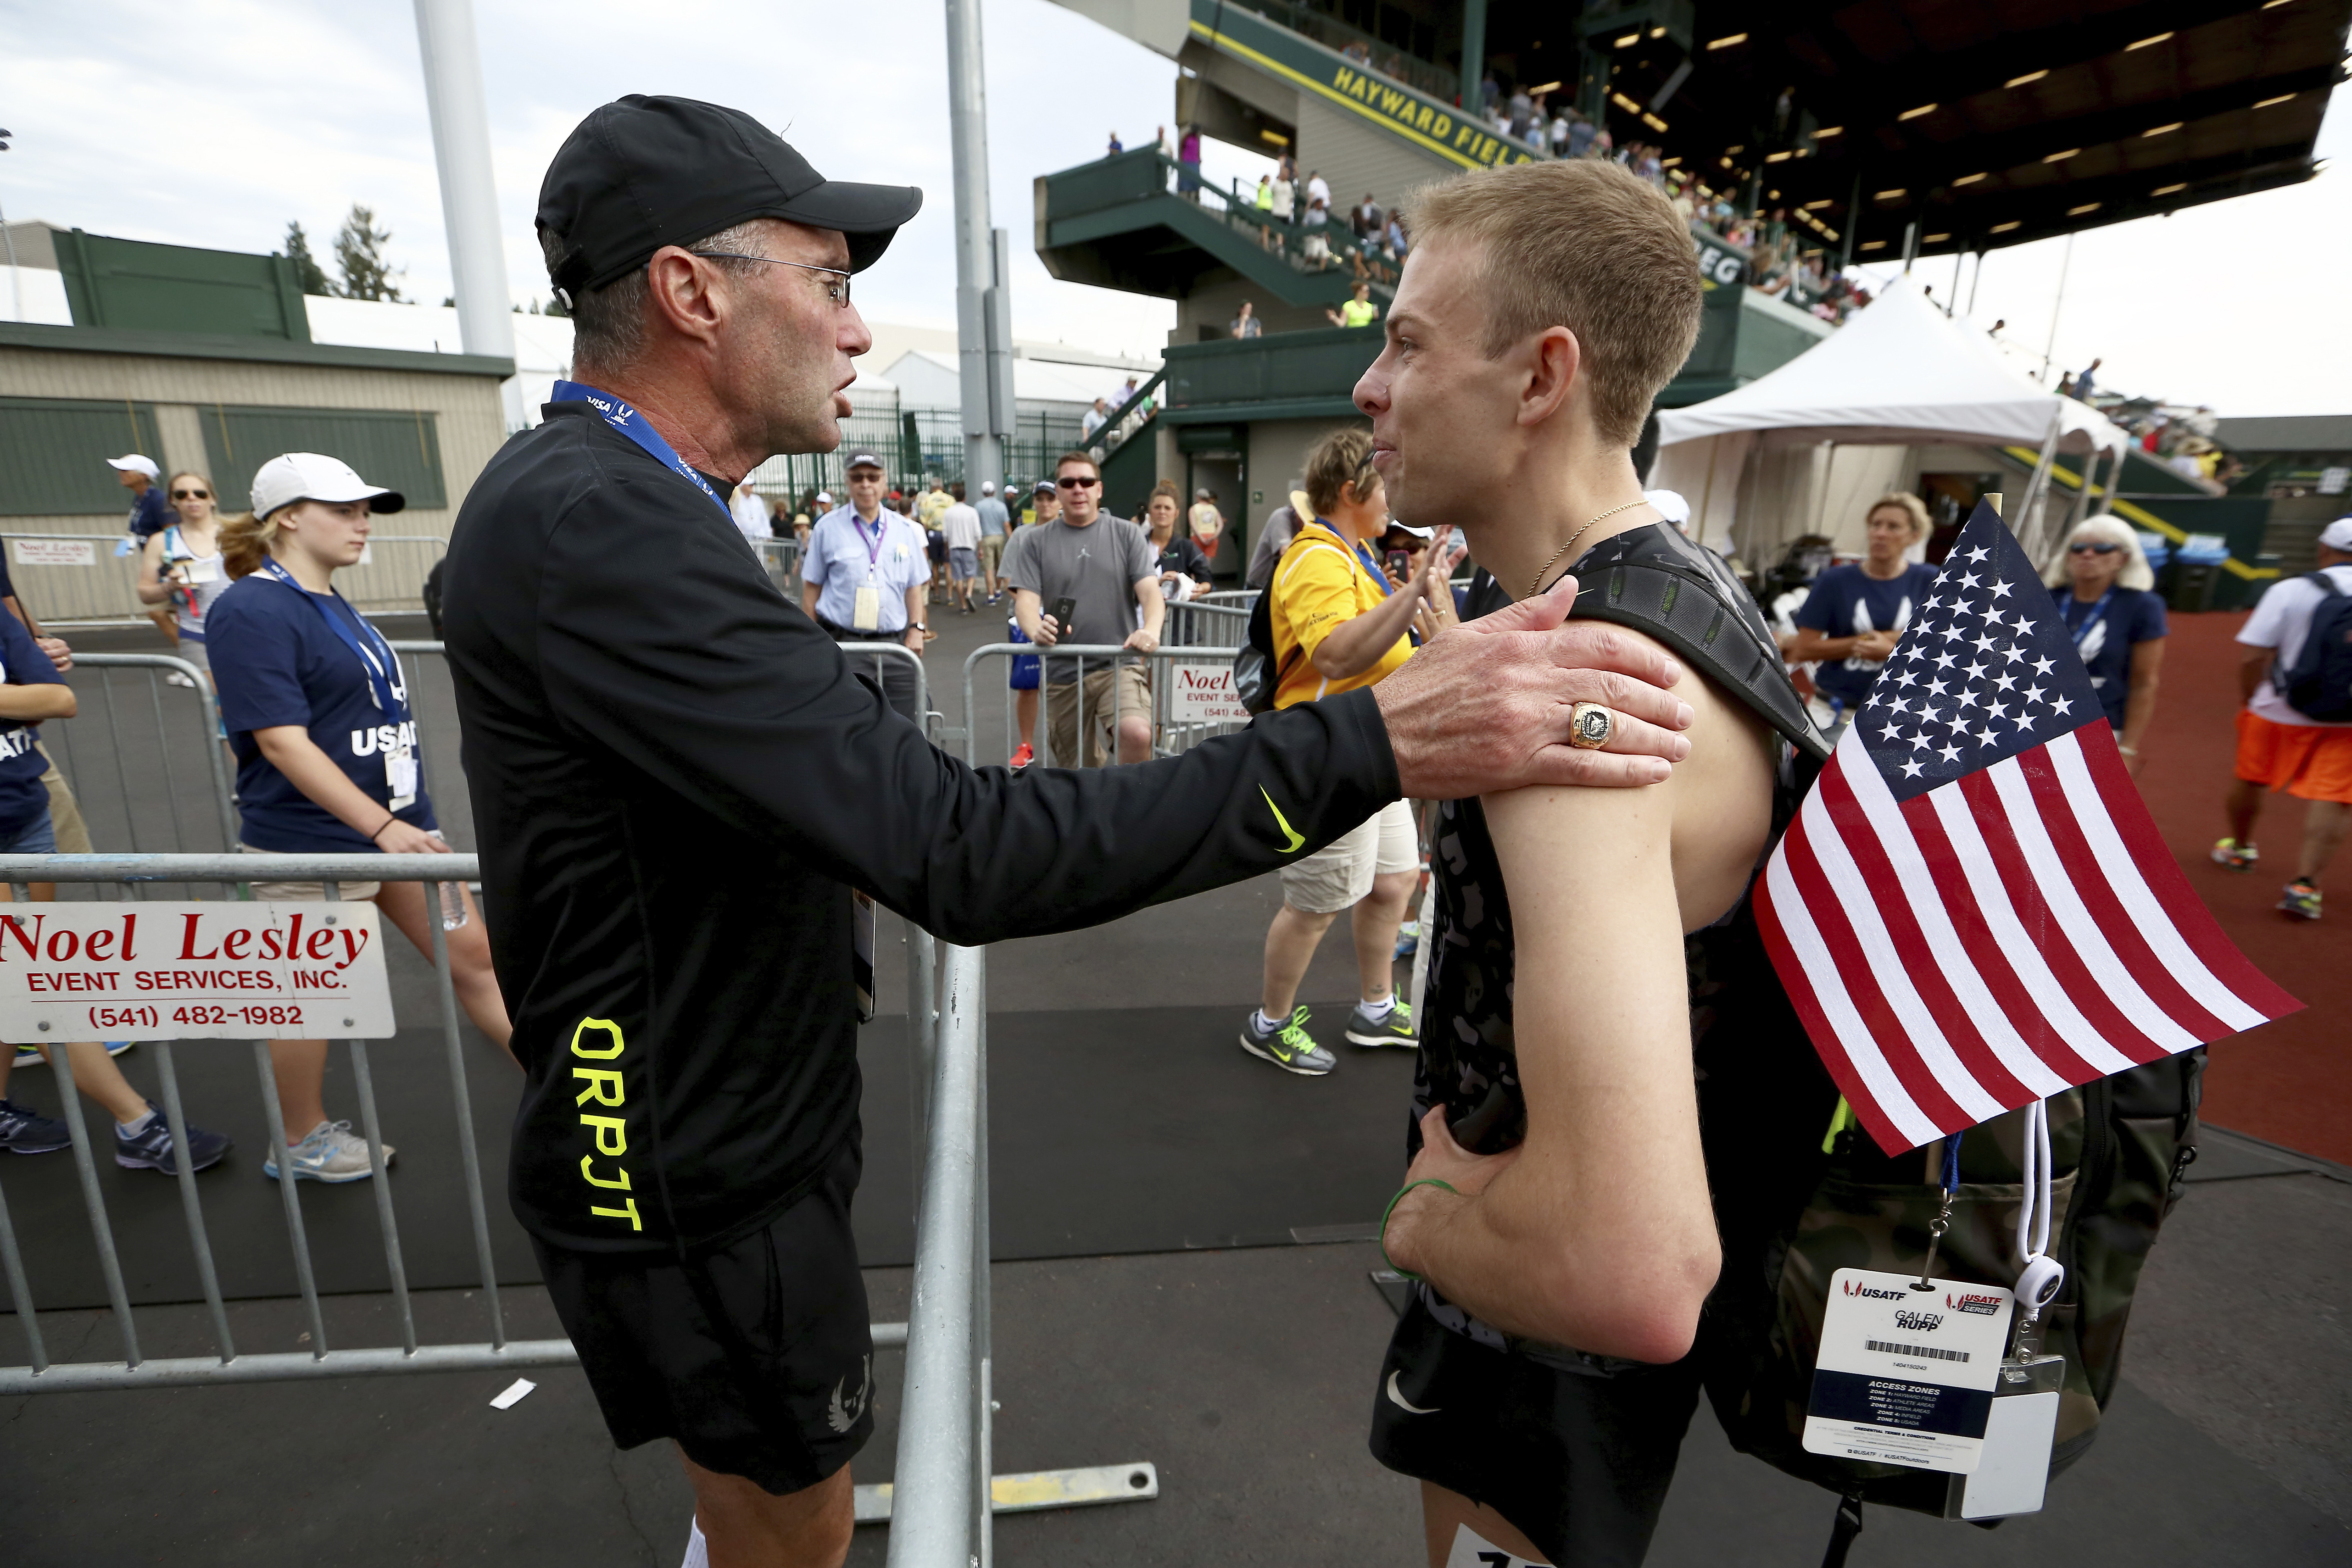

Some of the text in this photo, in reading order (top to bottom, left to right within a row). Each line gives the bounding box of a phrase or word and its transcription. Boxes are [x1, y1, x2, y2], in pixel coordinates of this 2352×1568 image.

[1333, 66, 1452, 139] HAYWARD
[586, 395, 611, 412] VISA
[677, 455, 697, 481] VISA
[1178, 669, 1230, 689] Noel
[1187, 693, 1219, 701] EVENT
[1204, 707, 1229, 717] (541)
[0, 913, 368, 969] Noel Lesley
[27, 969, 348, 993] EVENT SERVICES, INC.
[89, 1006, 304, 1029] (541) 482-1982
[571, 1016, 642, 1231] ORPJT
[1862, 1288, 1906, 1301] USATF
[1965, 1294, 2003, 1305] USATF
[1895, 1310, 1944, 1324] GALEN
[1963, 1306, 1994, 1314] SERIES
[1897, 1319, 1938, 1332] RUPP
[1893, 1362, 1927, 1371] 1404150243
[1868, 1381, 1941, 1395] ACCESS ZONES
[1884, 1454, 1930, 1464] #USATFoutdoors
